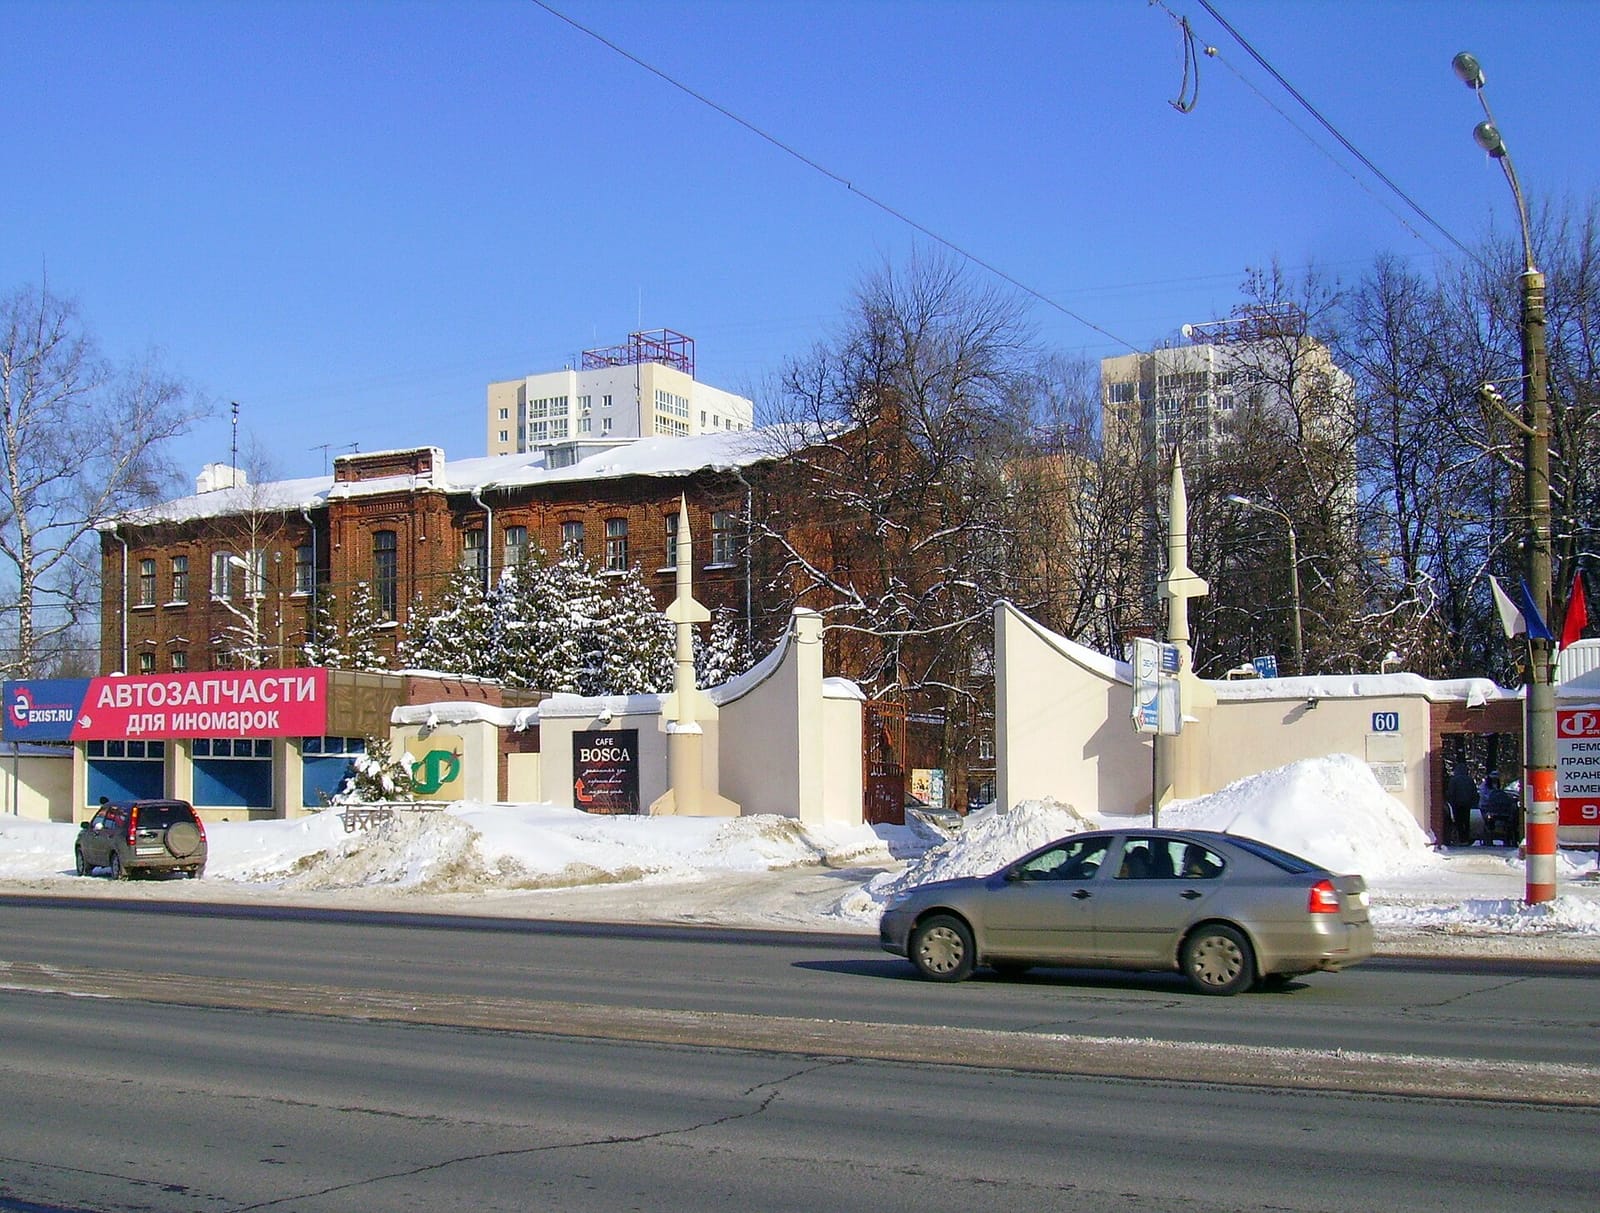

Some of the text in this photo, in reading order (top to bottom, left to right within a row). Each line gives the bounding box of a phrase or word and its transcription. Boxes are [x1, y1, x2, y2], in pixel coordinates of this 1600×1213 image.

[97, 677, 315, 708] АВТОЗАПЧАСТИ
[28, 709, 73, 722] EXIST.RU
[1375, 713, 1395, 731] 60
[126, 710, 280, 736] для иномарок
[595, 738, 614, 746] CAFE
[580, 748, 631, 762] BOSCA
[1563, 784, 1600, 793] ЗАМЕ
